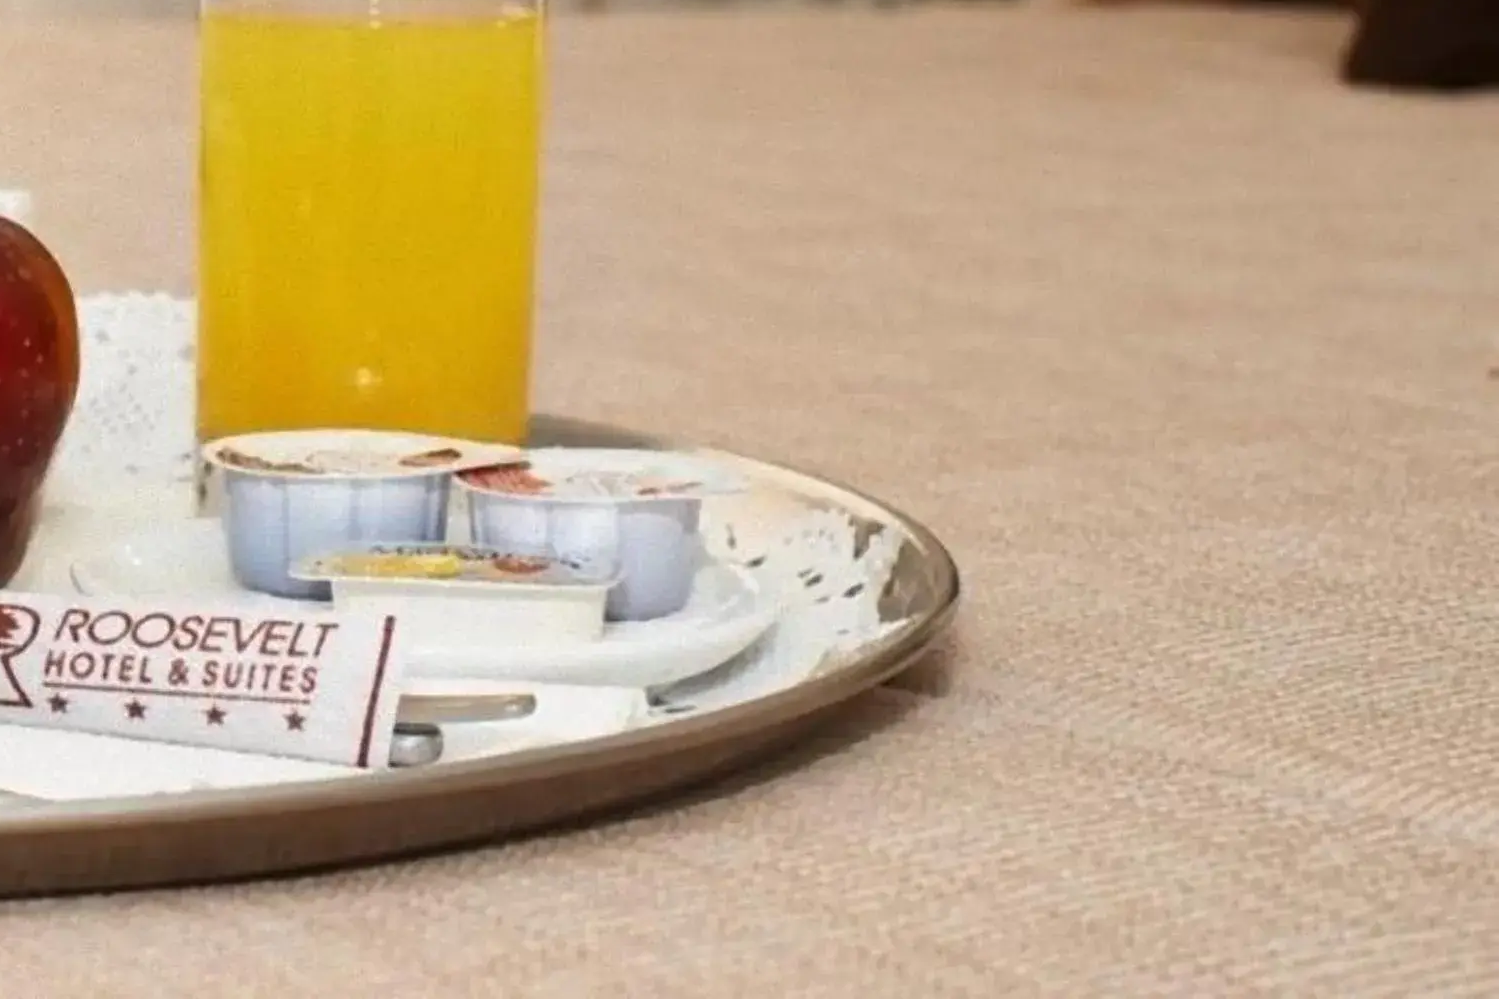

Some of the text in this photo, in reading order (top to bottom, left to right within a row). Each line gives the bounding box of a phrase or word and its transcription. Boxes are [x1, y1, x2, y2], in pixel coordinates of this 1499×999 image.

[53, 608, 339, 658] ROOSEVELT
[43, 648, 319, 694] HOTEL & SUITES
